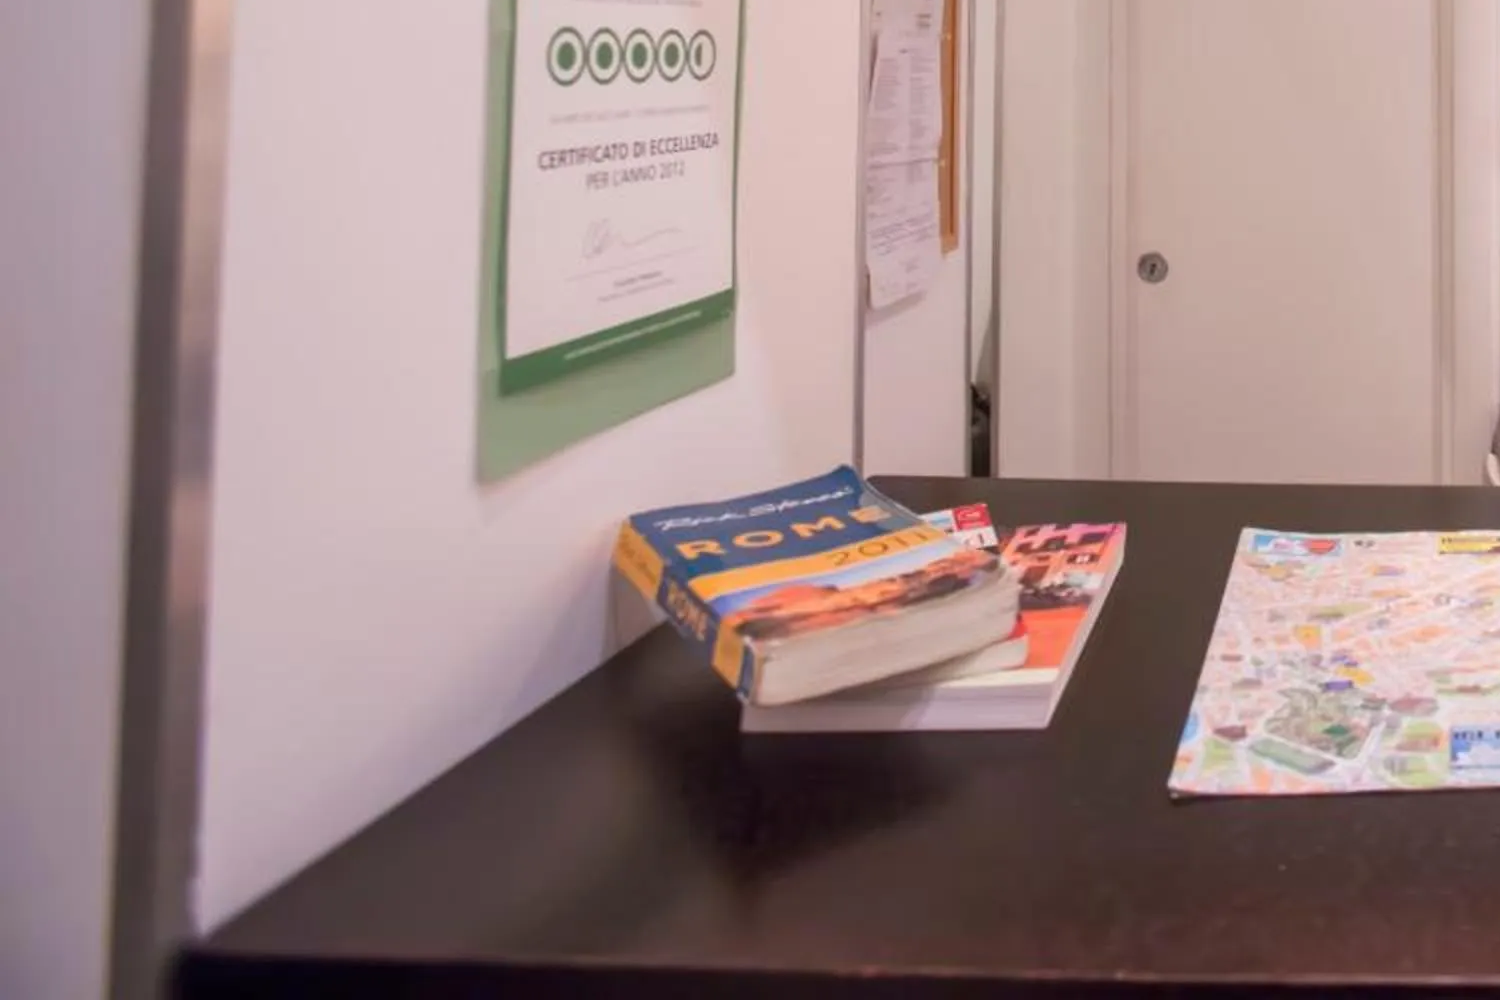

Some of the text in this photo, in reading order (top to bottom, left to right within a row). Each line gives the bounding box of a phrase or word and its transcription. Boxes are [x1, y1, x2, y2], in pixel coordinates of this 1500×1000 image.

[538, 132, 719, 171] CERTIFICATO DI ECCELLENZA
[586, 161, 685, 190] PER L'ANNO 2012
[676, 504, 892, 560] ROME
[826, 528, 929, 567] 2011
